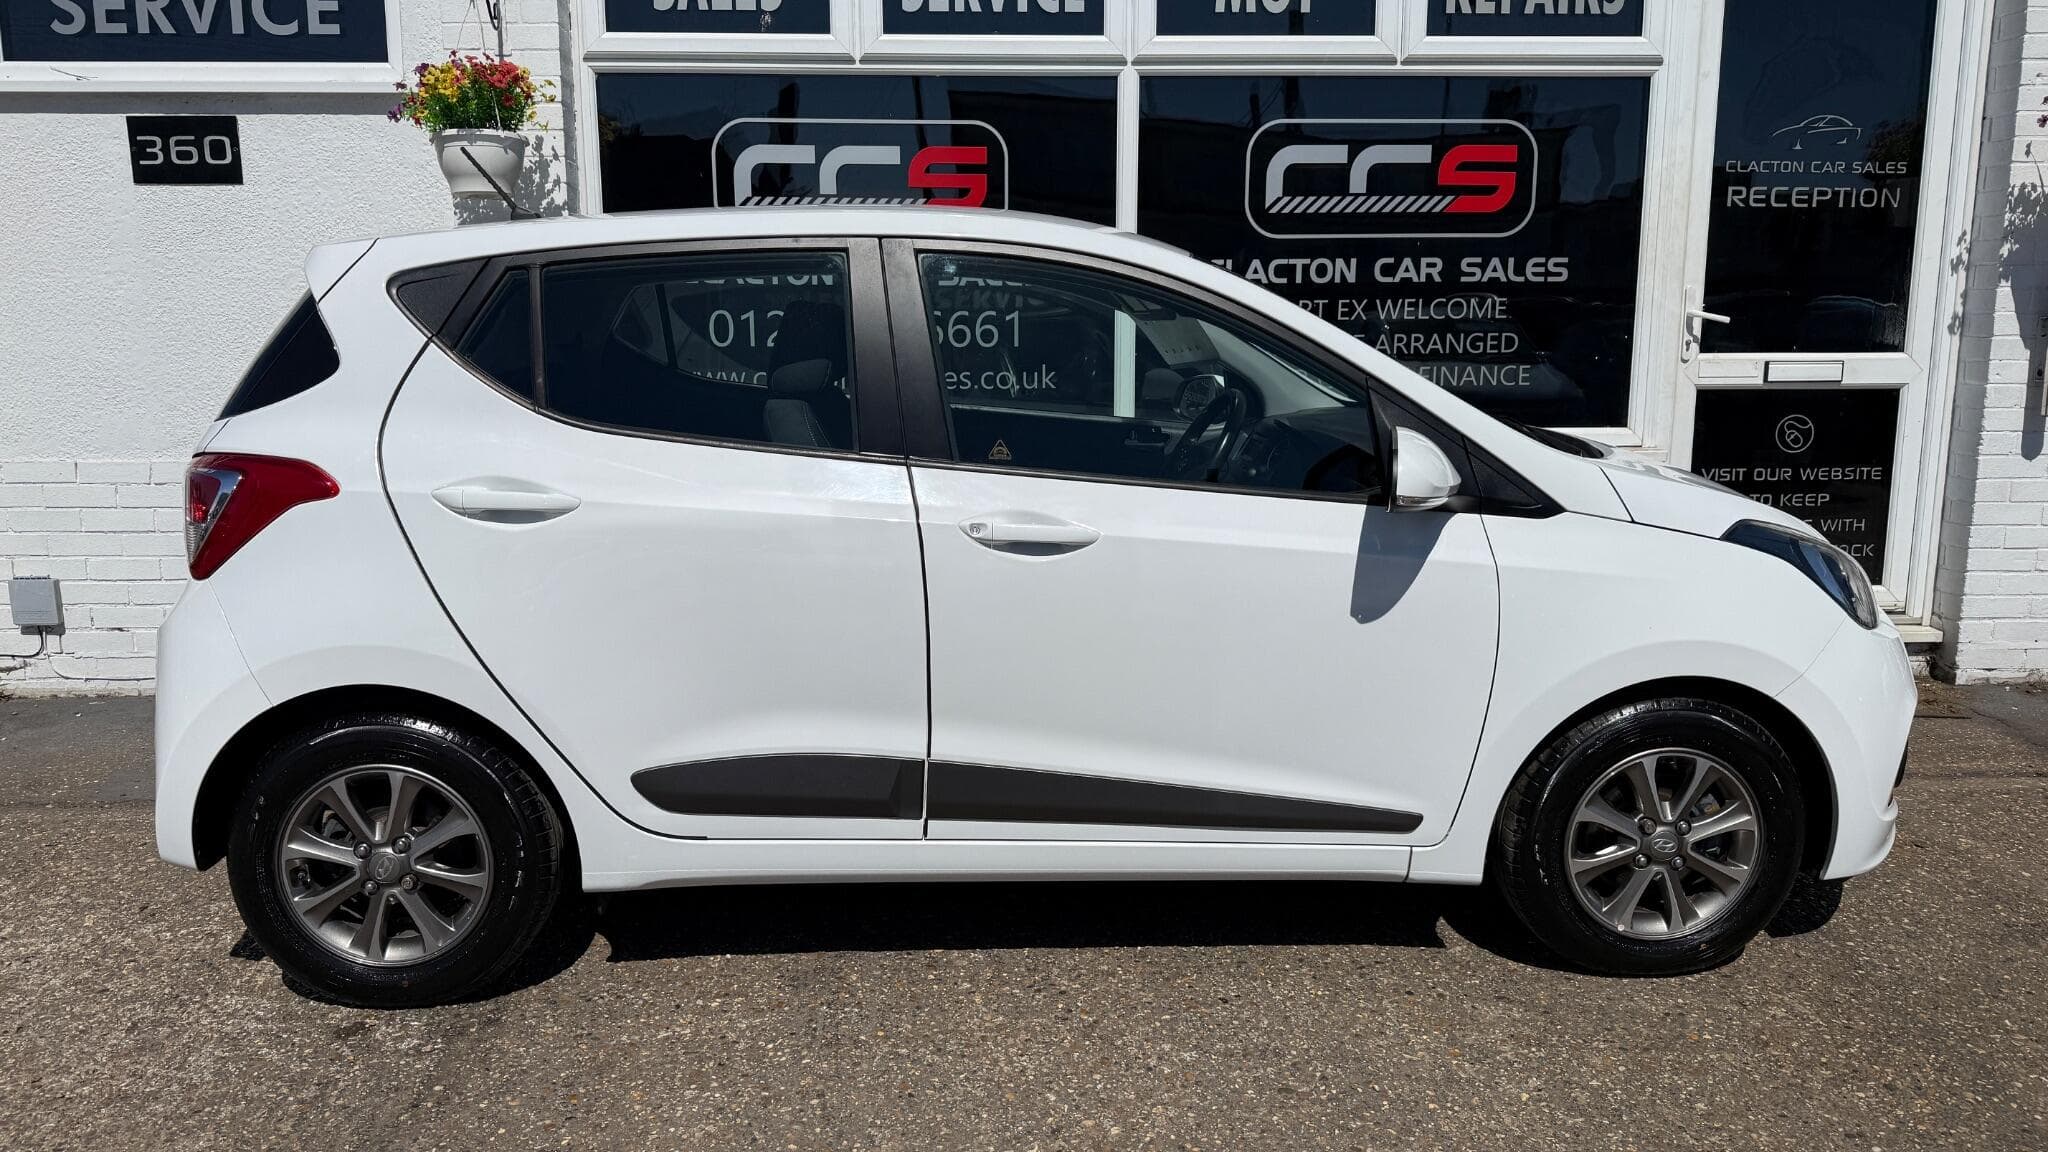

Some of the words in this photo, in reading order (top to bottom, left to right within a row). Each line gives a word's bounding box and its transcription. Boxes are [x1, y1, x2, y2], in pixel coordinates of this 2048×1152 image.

[50, 0, 341, 36] SERVICE
[136, 135, 233, 165] 360
[1725, 160, 1804, 173] CLACTON
[1810, 161, 1846, 174] CAR
[1851, 161, 1907, 174] SALES
[1726, 185, 1901, 208] RECEPTION
[1211, 258, 1357, 284] ACTON
[1373, 257, 1443, 283] CAR
[1460, 256, 1569, 283] SALES
[1337, 299, 1368, 321] EX
[1375, 332, 1519, 355] ARRANGED
[1701, 468, 1747, 481] VISIT
[1753, 467, 1792, 481] OUR
[1800, 467, 1883, 481] WEBSITE
[1779, 493, 1830, 507] KEEP
[1820, 518, 1866, 532] WITH
